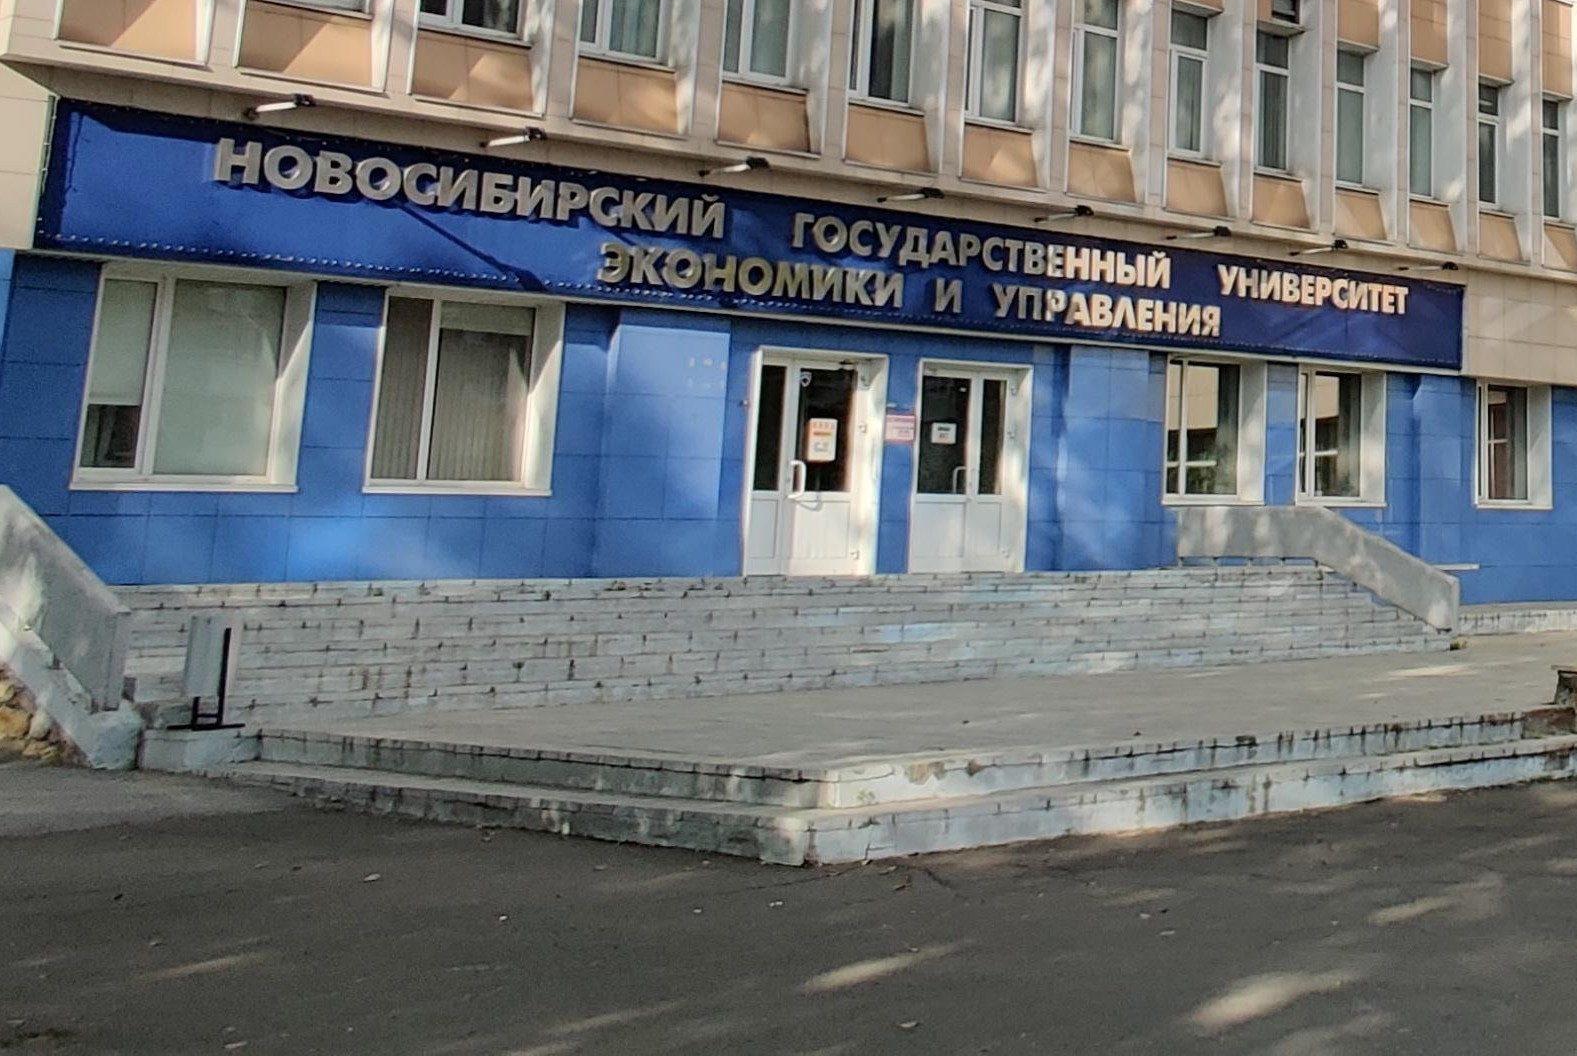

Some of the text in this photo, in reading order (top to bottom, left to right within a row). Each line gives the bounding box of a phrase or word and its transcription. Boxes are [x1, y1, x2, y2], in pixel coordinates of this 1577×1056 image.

[213, 137, 1409, 314] НОВОСИБИРСКИЙ ГОСУДАРСТВЕННЫЙ УНИВЕРСИТЕТ
[597, 243, 1221, 336] ЭКОНОМИКИ И УПРАВЛЕНИЯ
